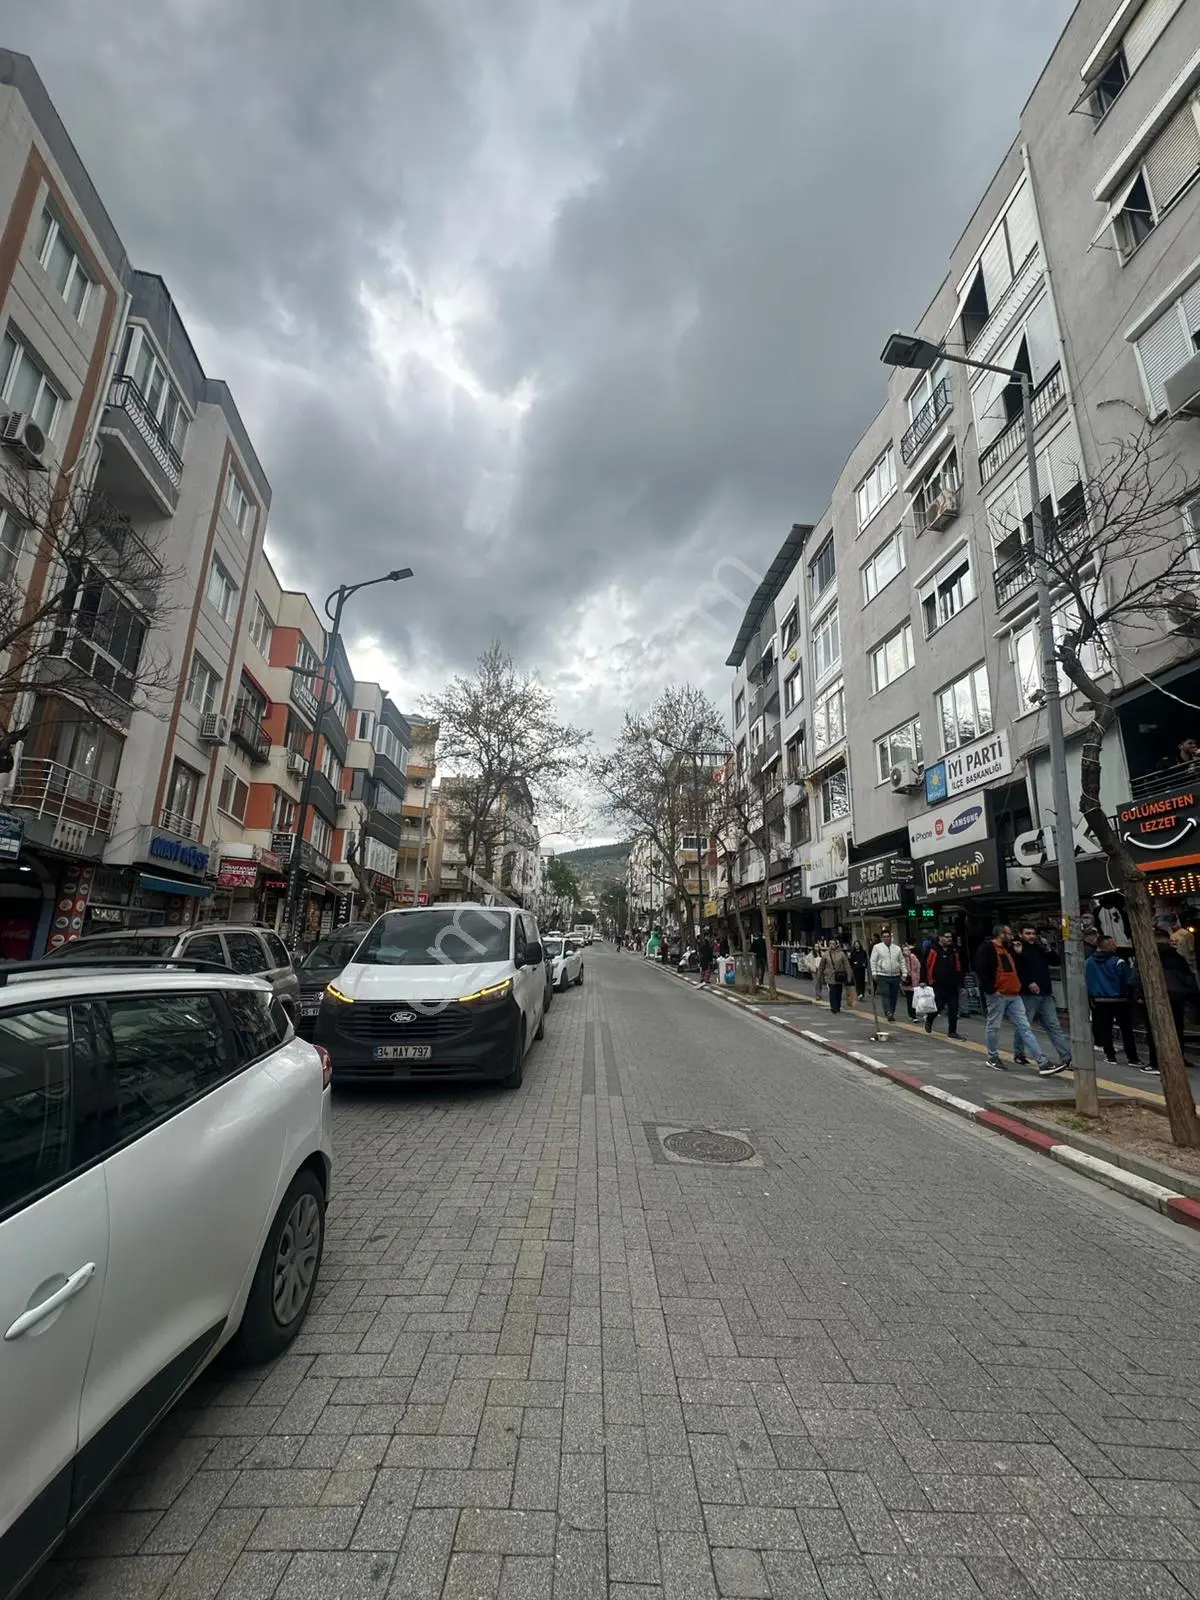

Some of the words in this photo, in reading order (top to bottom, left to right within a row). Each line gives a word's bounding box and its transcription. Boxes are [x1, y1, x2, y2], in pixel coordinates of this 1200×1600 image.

[947, 754, 962, 780] İYİ
[966, 735, 1003, 772] PARTİ
[1120, 793, 1195, 822] GÜLÜMSETEN
[951, 812, 979, 829] SAMSUNG
[1140, 815, 1177, 833] LEZZET
[378, 1047, 389, 1058] 34
[392, 1047, 409, 1058] MAY
[412, 1046, 429, 1058] 797
